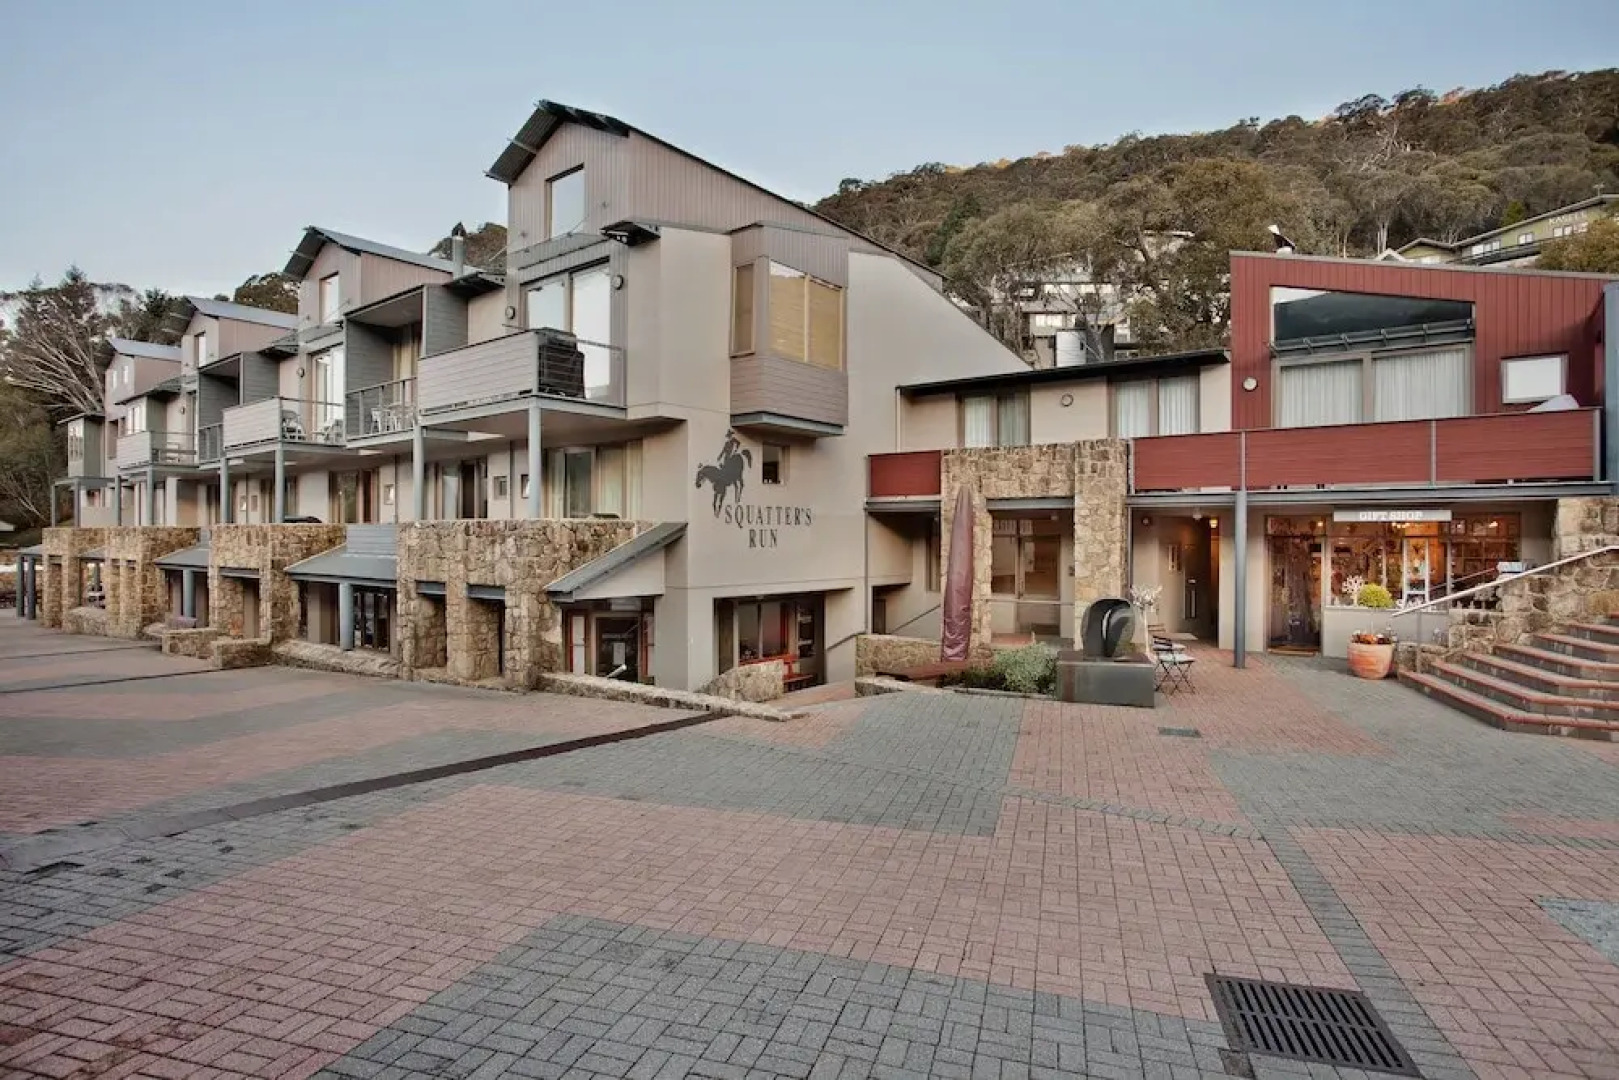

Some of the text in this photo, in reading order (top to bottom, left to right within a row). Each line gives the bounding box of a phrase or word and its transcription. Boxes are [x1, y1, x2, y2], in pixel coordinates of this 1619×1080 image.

[725, 505, 812, 528] SQUATTER'S
[1389, 511, 1423, 521] SHOP
[749, 529, 777, 548] RUN
